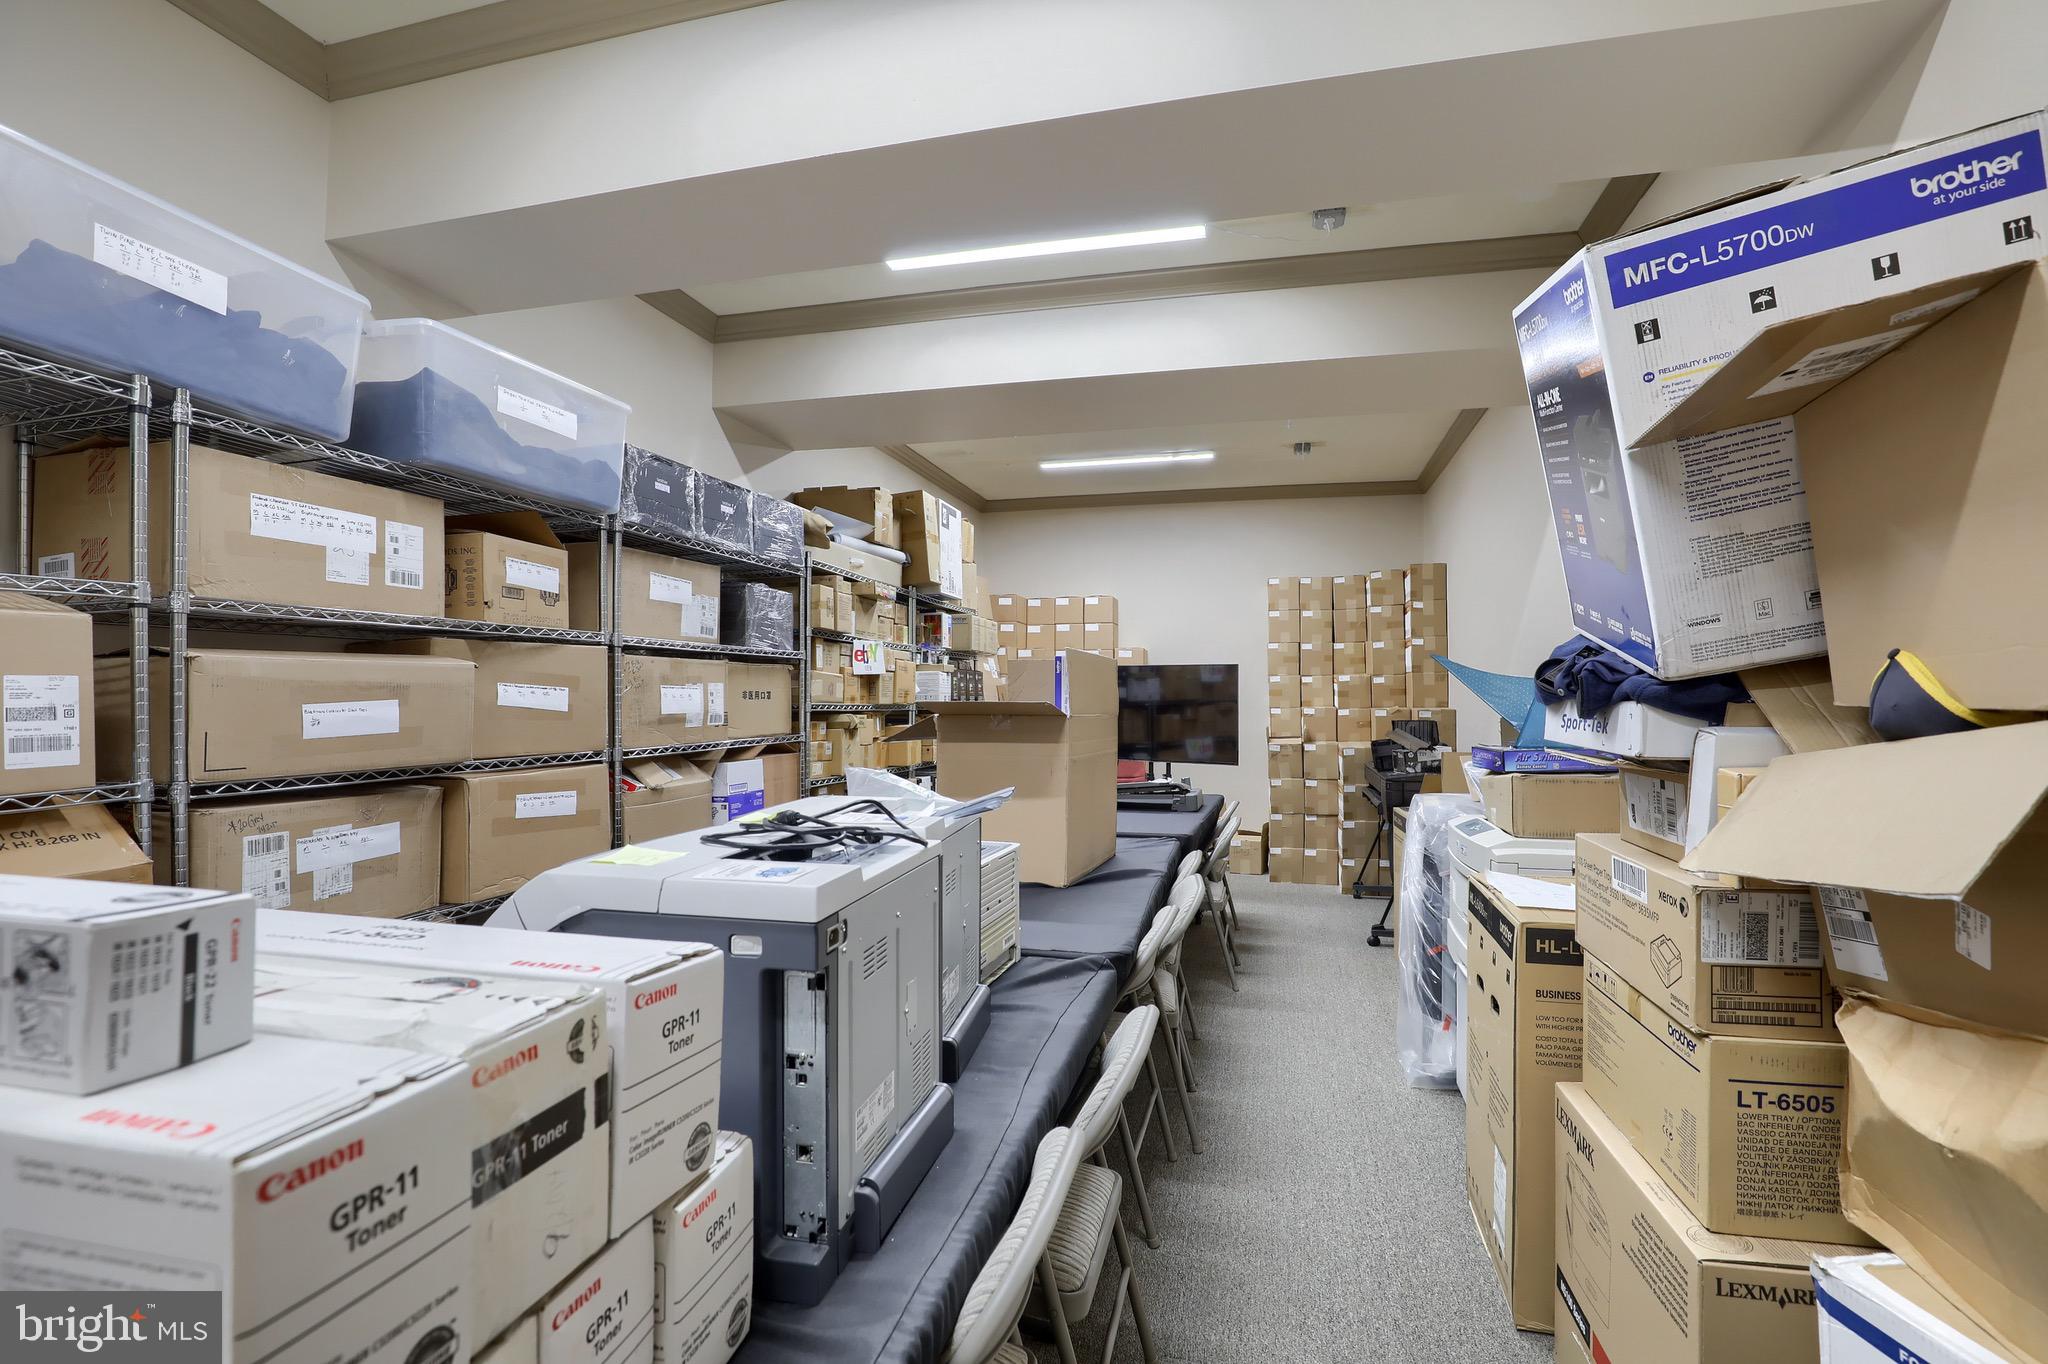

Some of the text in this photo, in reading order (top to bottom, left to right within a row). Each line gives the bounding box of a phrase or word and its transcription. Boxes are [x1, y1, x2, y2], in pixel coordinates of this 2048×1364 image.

[1910, 150, 2024, 198] brother
[1933, 176, 2006, 207] at your side
[1623, 223, 1815, 289] MFC-L5700DW
[1562, 278, 1585, 306] brother
[1659, 358, 1701, 375] RELIABILITY
[1536, 386, 1561, 409] ALL-IN-ONE
[1688, 617, 1721, 628] WINDOWS
[1758, 610, 1771, 618] Mac
[1560, 713, 1608, 735] Sport-Tek
[1515, 752, 1532, 763] Air
[10, 830, 38, 841] CM
[13, 832, 101, 849] H: 8.268 IN
[1658, 889, 1678, 909] xerox
[230, 917, 242, 963] Canon
[328, 928, 428, 941] GPR-11
[1500, 918, 1513, 942] brother
[204, 937, 219, 990] GPR-22
[511, 960, 601, 974] Canon
[634, 983, 678, 1010] Canon
[1536, 989, 1581, 1001] BUSINESS
[662, 1008, 700, 1039] GPR-11
[1567, 1016, 1579, 1024] FOR
[668, 1033, 694, 1054] Toner
[1536, 1035, 1558, 1043] COSTO
[1559, 1036, 1578, 1044] TOTAL
[1536, 1043, 1552, 1051] BAJO
[1553, 1044, 1570, 1052] PARA
[1668, 1021, 1696, 1054] brother
[1536, 1050, 1562, 1059] TAMAÑO
[1536, 1058, 1573, 1067] VOLÚMENES
[472, 1044, 539, 1088] Canon
[1737, 1090, 1835, 1113] LT-6505
[81, 1109, 219, 1140] Canon
[1737, 1112, 1768, 1121] LOWER
[1771, 1114, 1794, 1123] TRAY
[1737, 1120, 1754, 1128] BAC
[1757, 1121, 1804, 1131] INFERIEUR
[1556, 1098, 1595, 1172] LEXMARK
[1737, 1128, 1776, 1138] VASSOIO
[1778, 1130, 1807, 1139] CARTA
[1737, 1136, 1770, 1145] UNIDAD
[1787, 1140, 1827, 1149] BANDEJA
[472, 1120, 568, 1188] GPR-11 Toner
[1737, 1144, 1775, 1154] UNIDADE
[1793, 1148, 1832, 1158] BANDEJA
[256, 1137, 365, 1205] Canon
[1737, 1160, 1821, 1172] PODAJNIK PAPIERU
[1737, 1175, 1766, 1185] DONJA
[1769, 1178, 1799, 1187] LADICA
[1737, 1184, 1802, 1195] DONJA KASETA
[330, 1165, 418, 1233] GPR-11
[682, 1188, 717, 1228] Canon
[345, 1206, 407, 1252] Toner
[705, 1201, 736, 1243] GPR-11
[711, 1226, 732, 1254] Toner
[552, 1277, 601, 1331] Canon
[586, 1290, 629, 1343] GPR-11
[594, 1319, 622, 1357] Toner
